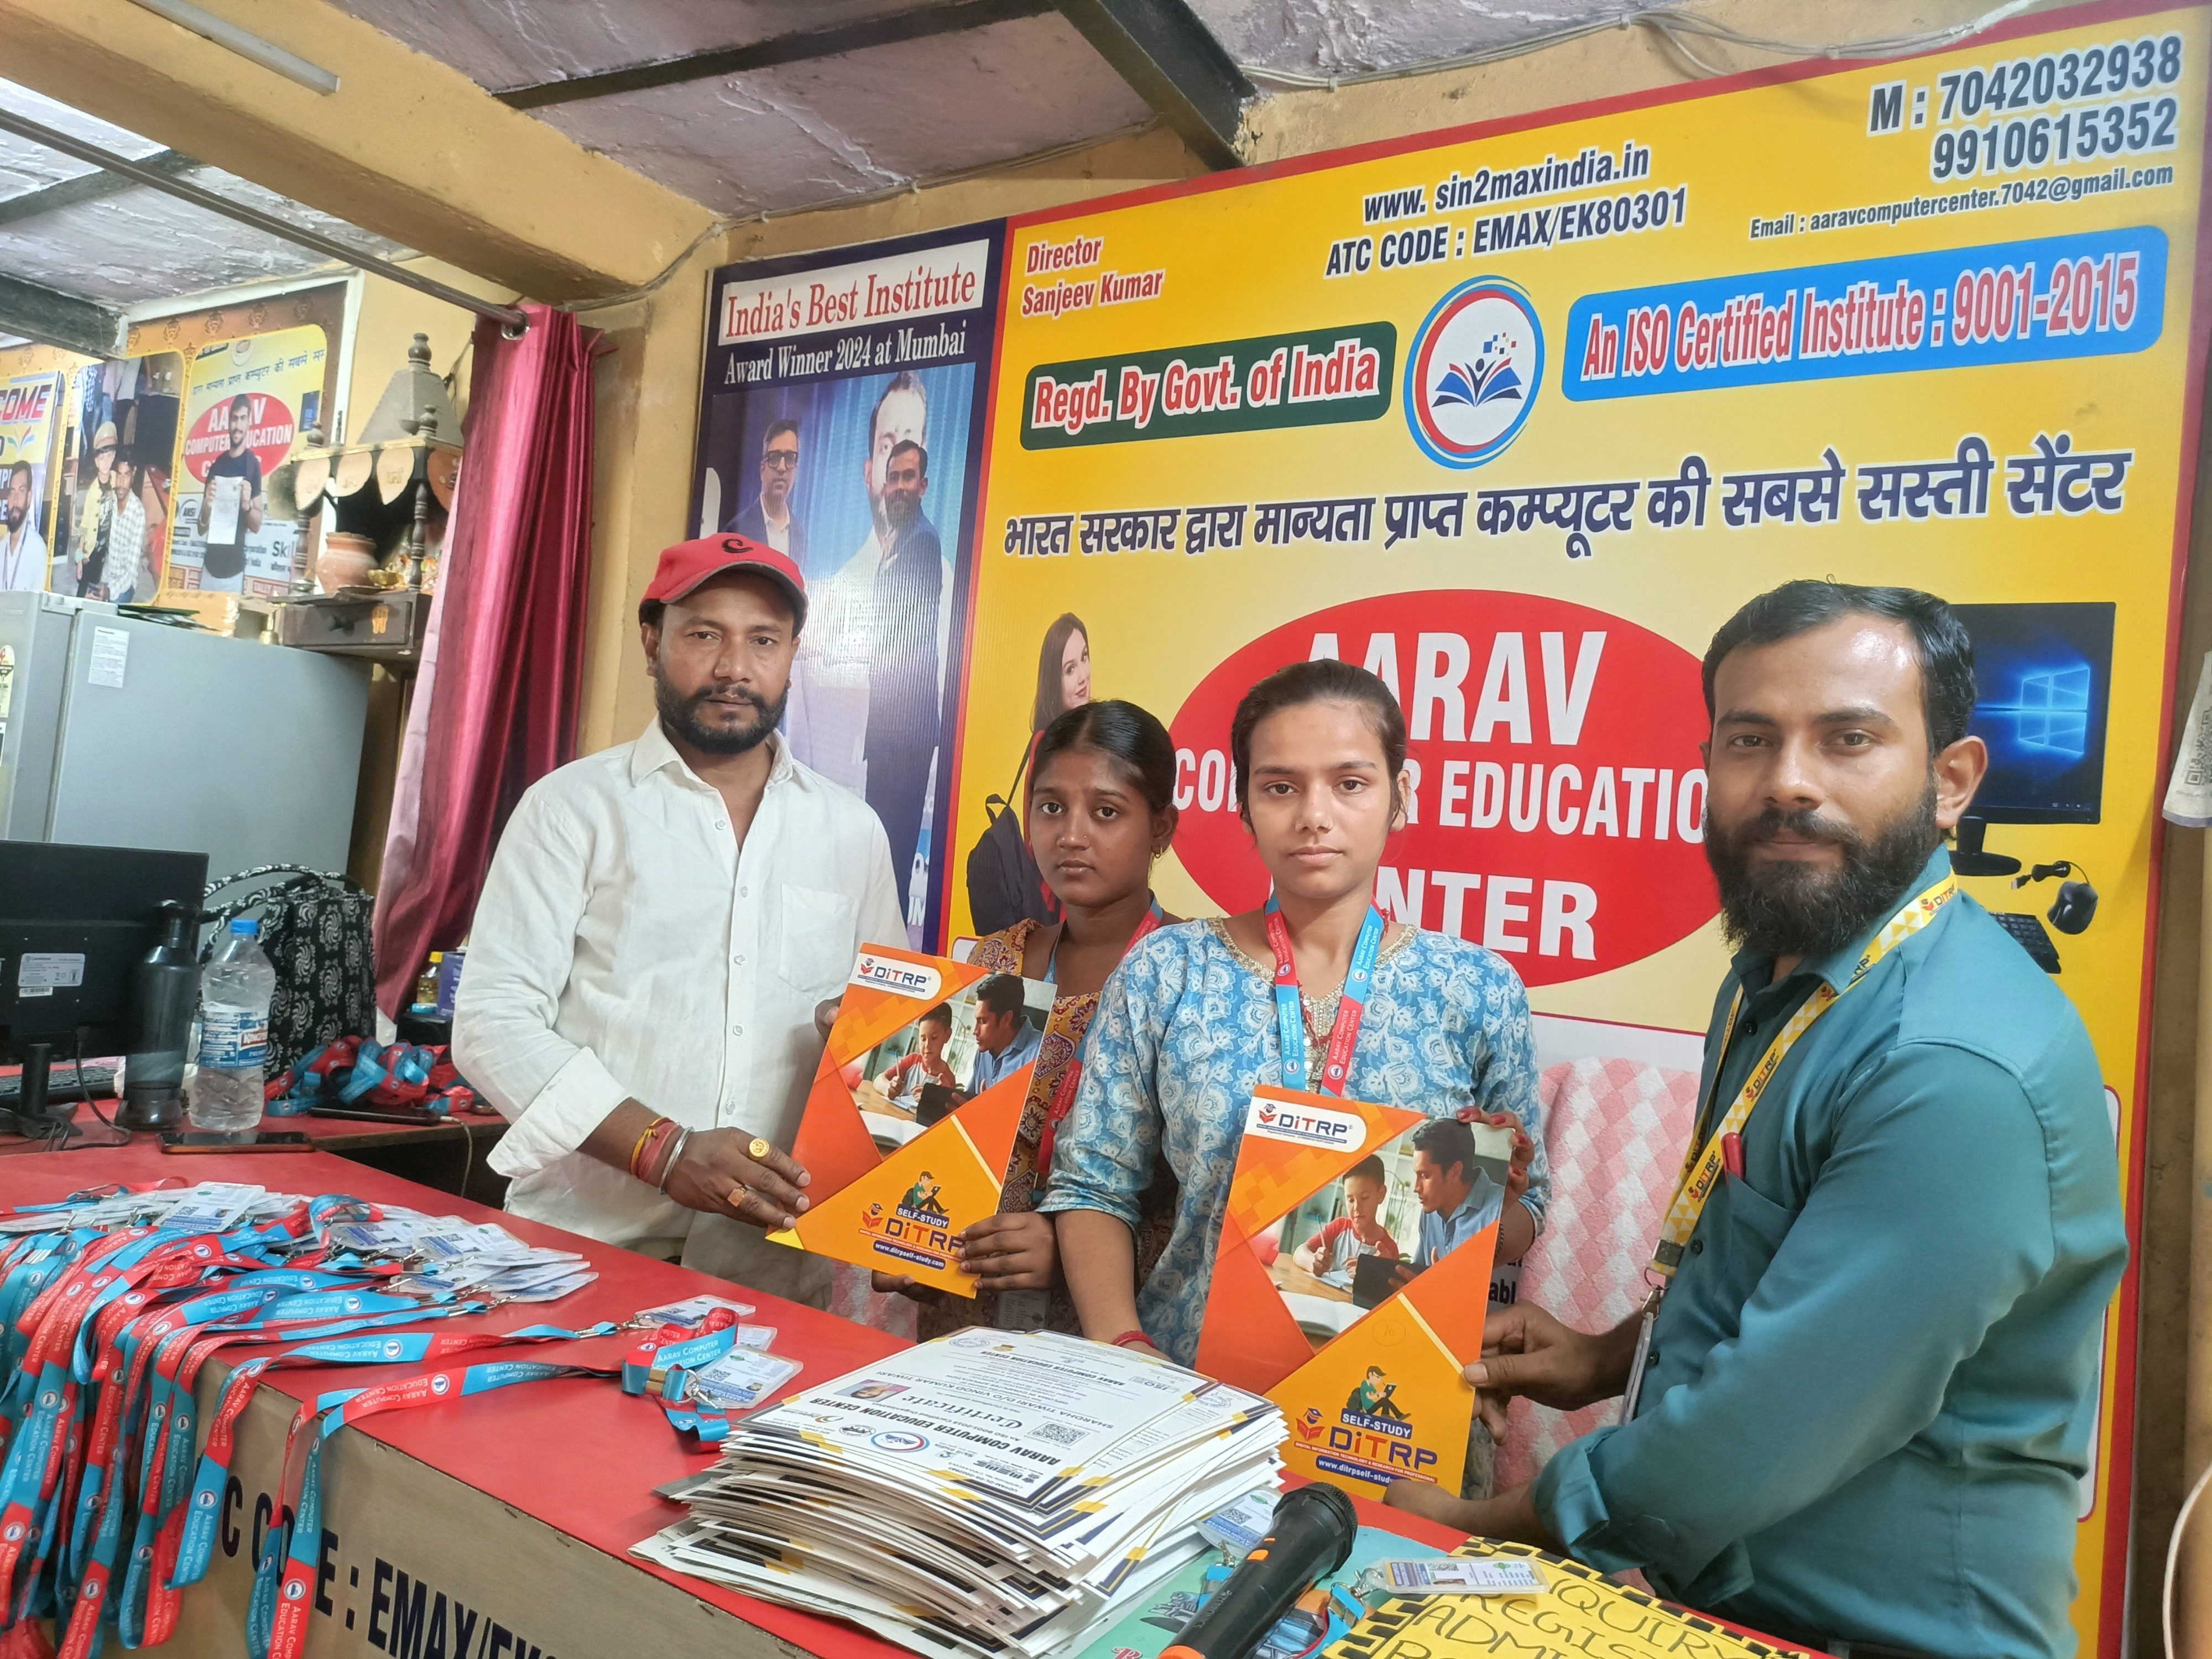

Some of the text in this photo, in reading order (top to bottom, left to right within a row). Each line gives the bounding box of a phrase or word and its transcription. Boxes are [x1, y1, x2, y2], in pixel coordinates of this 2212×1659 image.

[1871, 36, 2181, 131] M 7042032938
[1934, 97, 2176, 177] 9910615352
[1435, 143, 1648, 210] sin2maxindia.in
[1750, 165, 2173, 238] Email aaravcomputercenter.7042@gmail.com
[1327, 187, 1686, 276] ATC CODE EMAX/EK80301
[1027, 237, 1102, 273] Director
[726, 261, 975, 338] India's Best Institute
[1022, 271, 1164, 317] Sanjeev Kumar
[1584, 257, 2139, 377] An ISO Certified Institute 9001-2015
[724, 320, 967, 385] Award Winner 2024 at Mumbai
[1034, 344, 1376, 430] Regd. By Govt. of India
[208, 397, 267, 433] AAV
[1004, 434, 2132, 559] भारत सरकार द्वारा मान्यता प्राप्त कम्प्यूटर की सबसे सस्ती सेंटर
[1439, 760, 1709, 844] EDUCATIO
[1376, 867, 1597, 961] NTER
[1357, 925, 1373, 966] AARAV COMPUTER
[1363, 927, 1379, 970] EDUCATION CENTER
[1290, 1024, 1298, 1057] EDUCATION
[1333, 1010, 1349, 1061] AARAV COMPUTER
[1339, 1010, 1358, 1065] EDUCATION CENTER
[897, 1207, 948, 1228] SELF-STUDY
[875, 1243, 945, 1268] www.ditrpself-study.com
[303, 1296, 343, 1306] EDUCATION
[316, 1305, 340, 1313] AARAV
[336, 1339, 382, 1350] EDUCATION
[352, 1350, 378, 1358] AARAV
[658, 1339, 719, 1363] AARAV COMPUTER
[696, 1348, 721, 1361] CENTER
[486, 1364, 513, 1373] CENTER
[873, 1371, 915, 1380] TIWARI
[354, 1378, 429, 1403] EDUCATION CENTER
[913, 1378, 957, 1388] KUMAR
[953, 1385, 993, 1396] VINOD
[362, 1389, 427, 1408] AARAV COMPUTER
[807, 1397, 863, 1411] CENTER
[869, 1402, 921, 1414] Organization
[989, 1394, 1019, 1402] D/O
[1013, 1400, 1058, 1412] TIWARI
[857, 1407, 936, 1428] EDUCATION
[896, 1394, 1027, 1431] Certificate
[915, 1412, 954, 1423] Certified
[1056, 1410, 1115, 1428] SHARDHA
[1342, 1413, 1411, 1438] SELF-STUDY
[96, 1426, 109, 1455] CENTER
[931, 1424, 1013, 1450] COMPUTER
[1008, 1446, 1062, 1465] AARAV
[1311, 1444, 1340, 1457] INFORMATION
[1340, 1452, 1368, 1464] TECHNOLOGY
[1372, 1460, 1395, 1472] RESEARCH
[1404, 1469, 1436, 1483] PROFESSIONAL
[290, 1606, 302, 1634] AARAV
